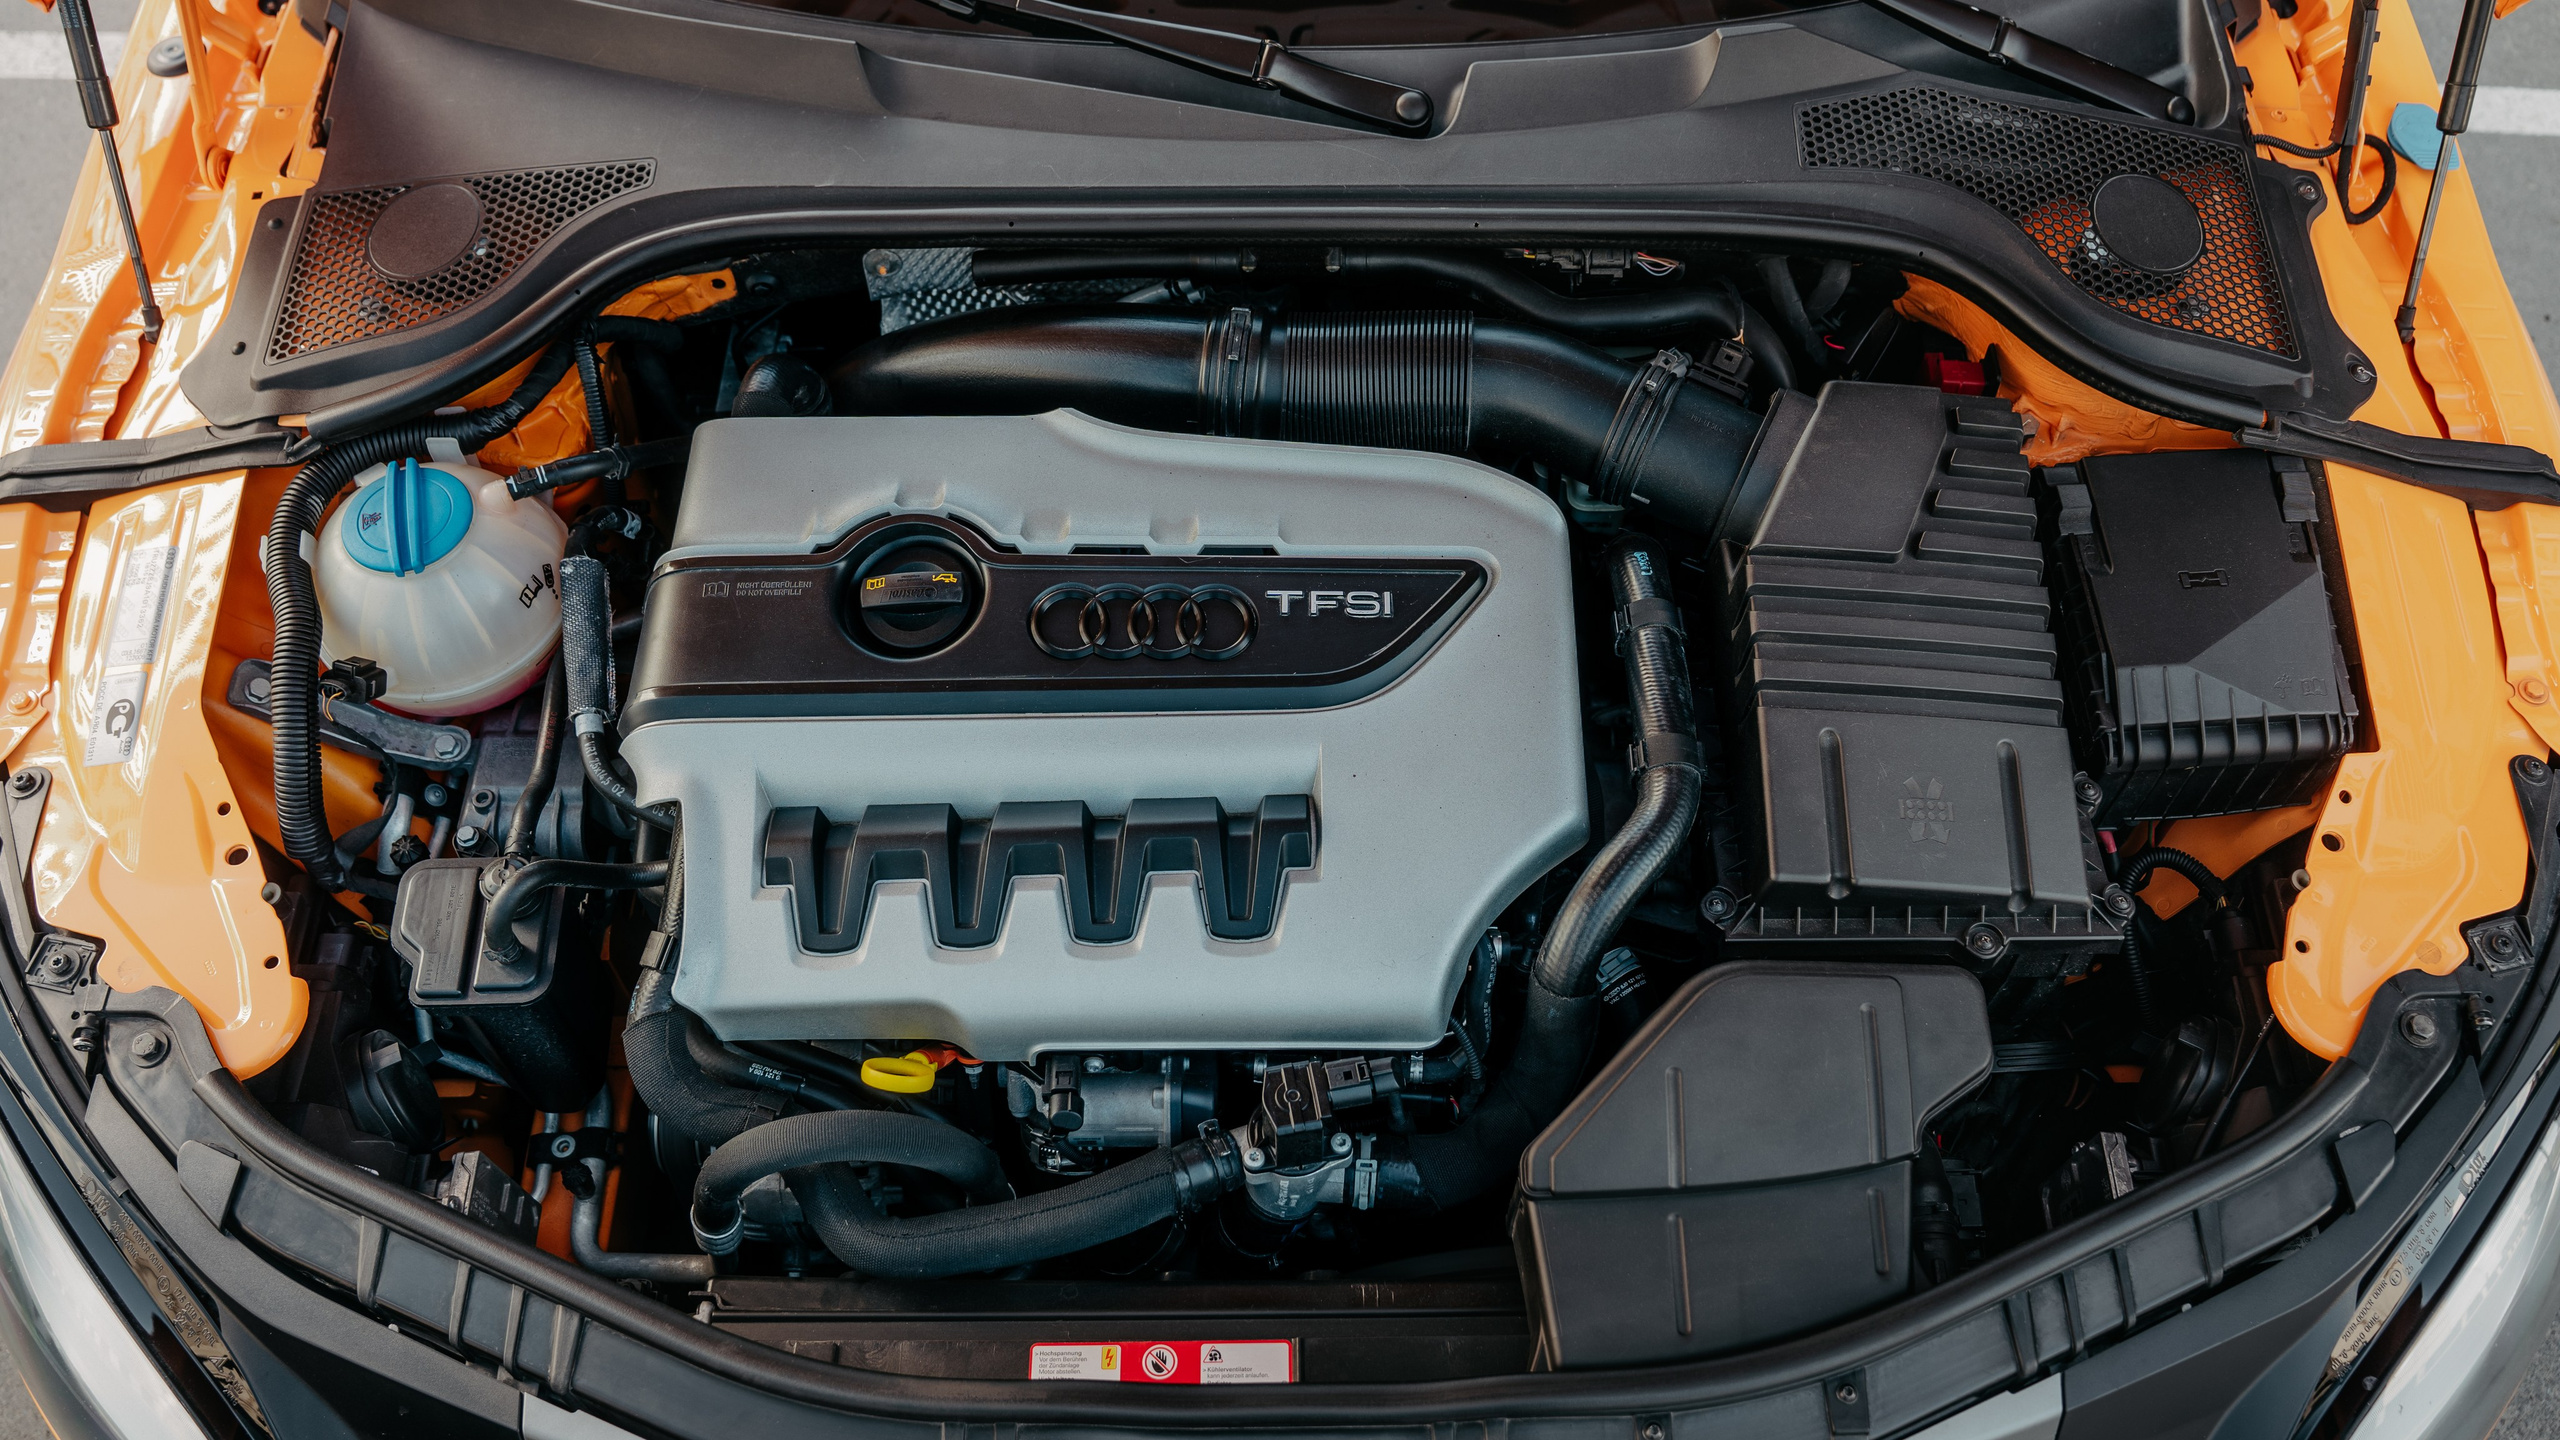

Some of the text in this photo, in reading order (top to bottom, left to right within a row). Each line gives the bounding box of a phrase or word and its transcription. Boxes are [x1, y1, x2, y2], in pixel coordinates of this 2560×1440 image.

[737, 581, 759, 589] NICHT
[888, 587, 924, 600] Castrol
[155, 589, 167, 623] HUNGARIA
[1265, 590, 1394, 618] TFSI
[150, 624, 159, 648] MOTOR
[585, 741, 598, 757] VRT
[611, 783, 625, 797] 02
[652, 805, 665, 817] 03
